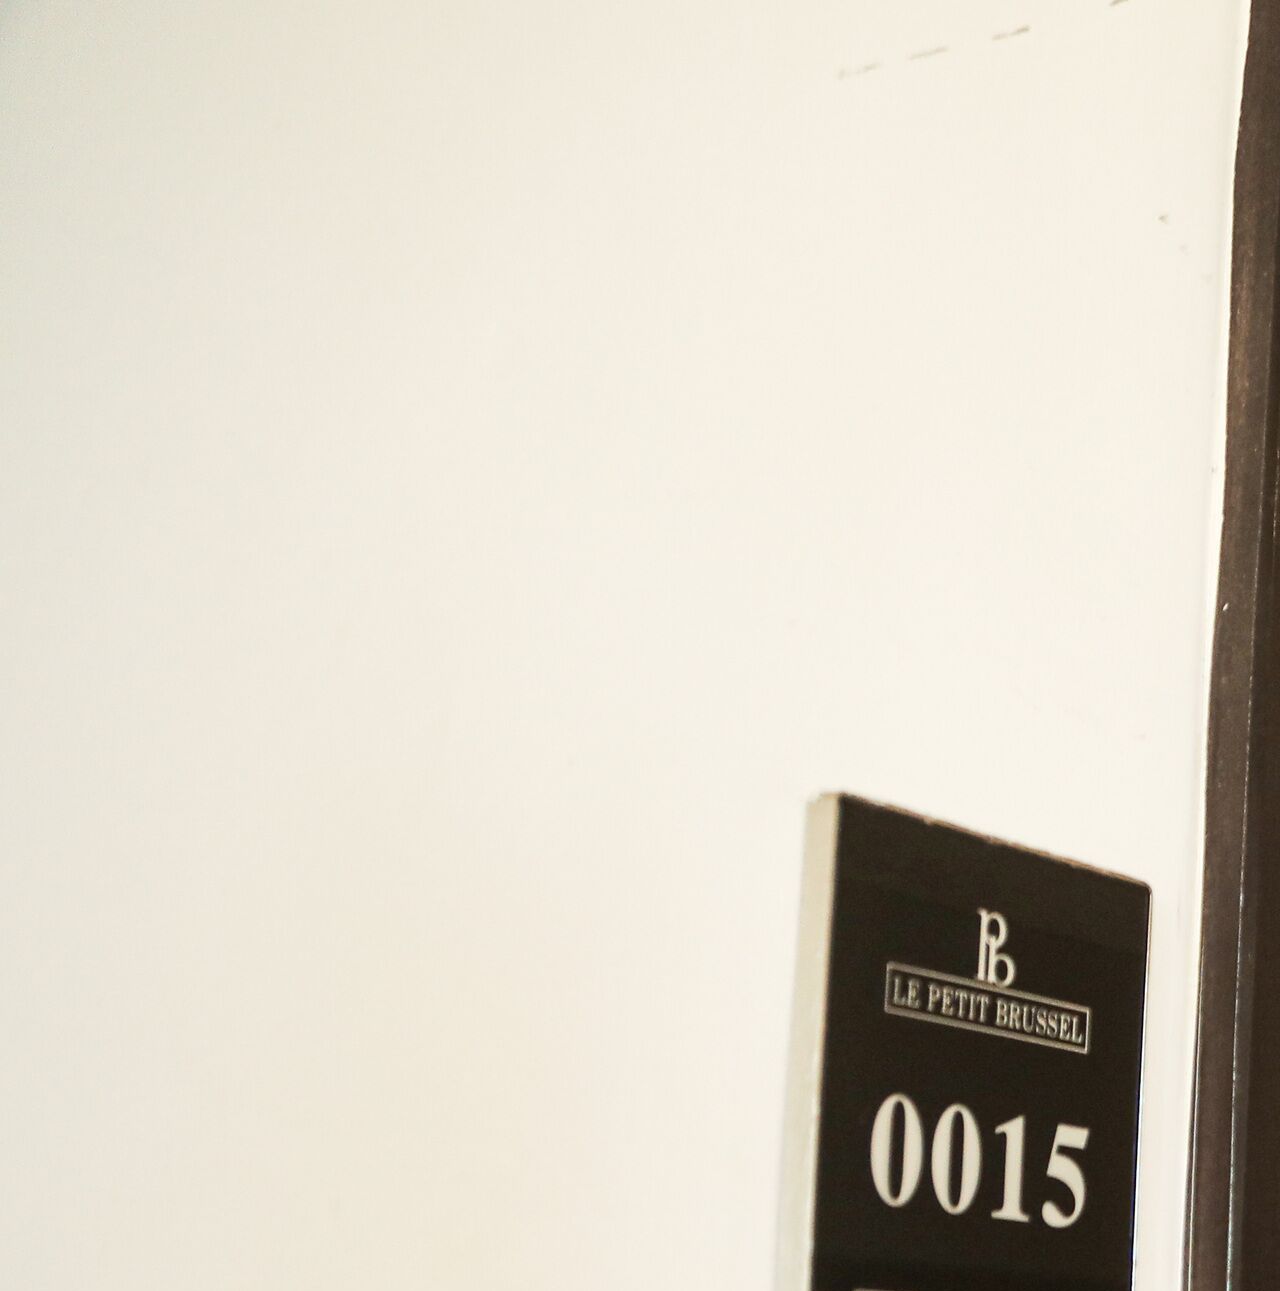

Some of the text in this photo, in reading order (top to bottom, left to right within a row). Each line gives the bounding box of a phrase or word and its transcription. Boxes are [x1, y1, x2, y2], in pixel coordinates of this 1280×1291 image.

[893, 977, 1084, 1044] LE PETIT BRUSSEL
[870, 1092, 1090, 1228] 0015
